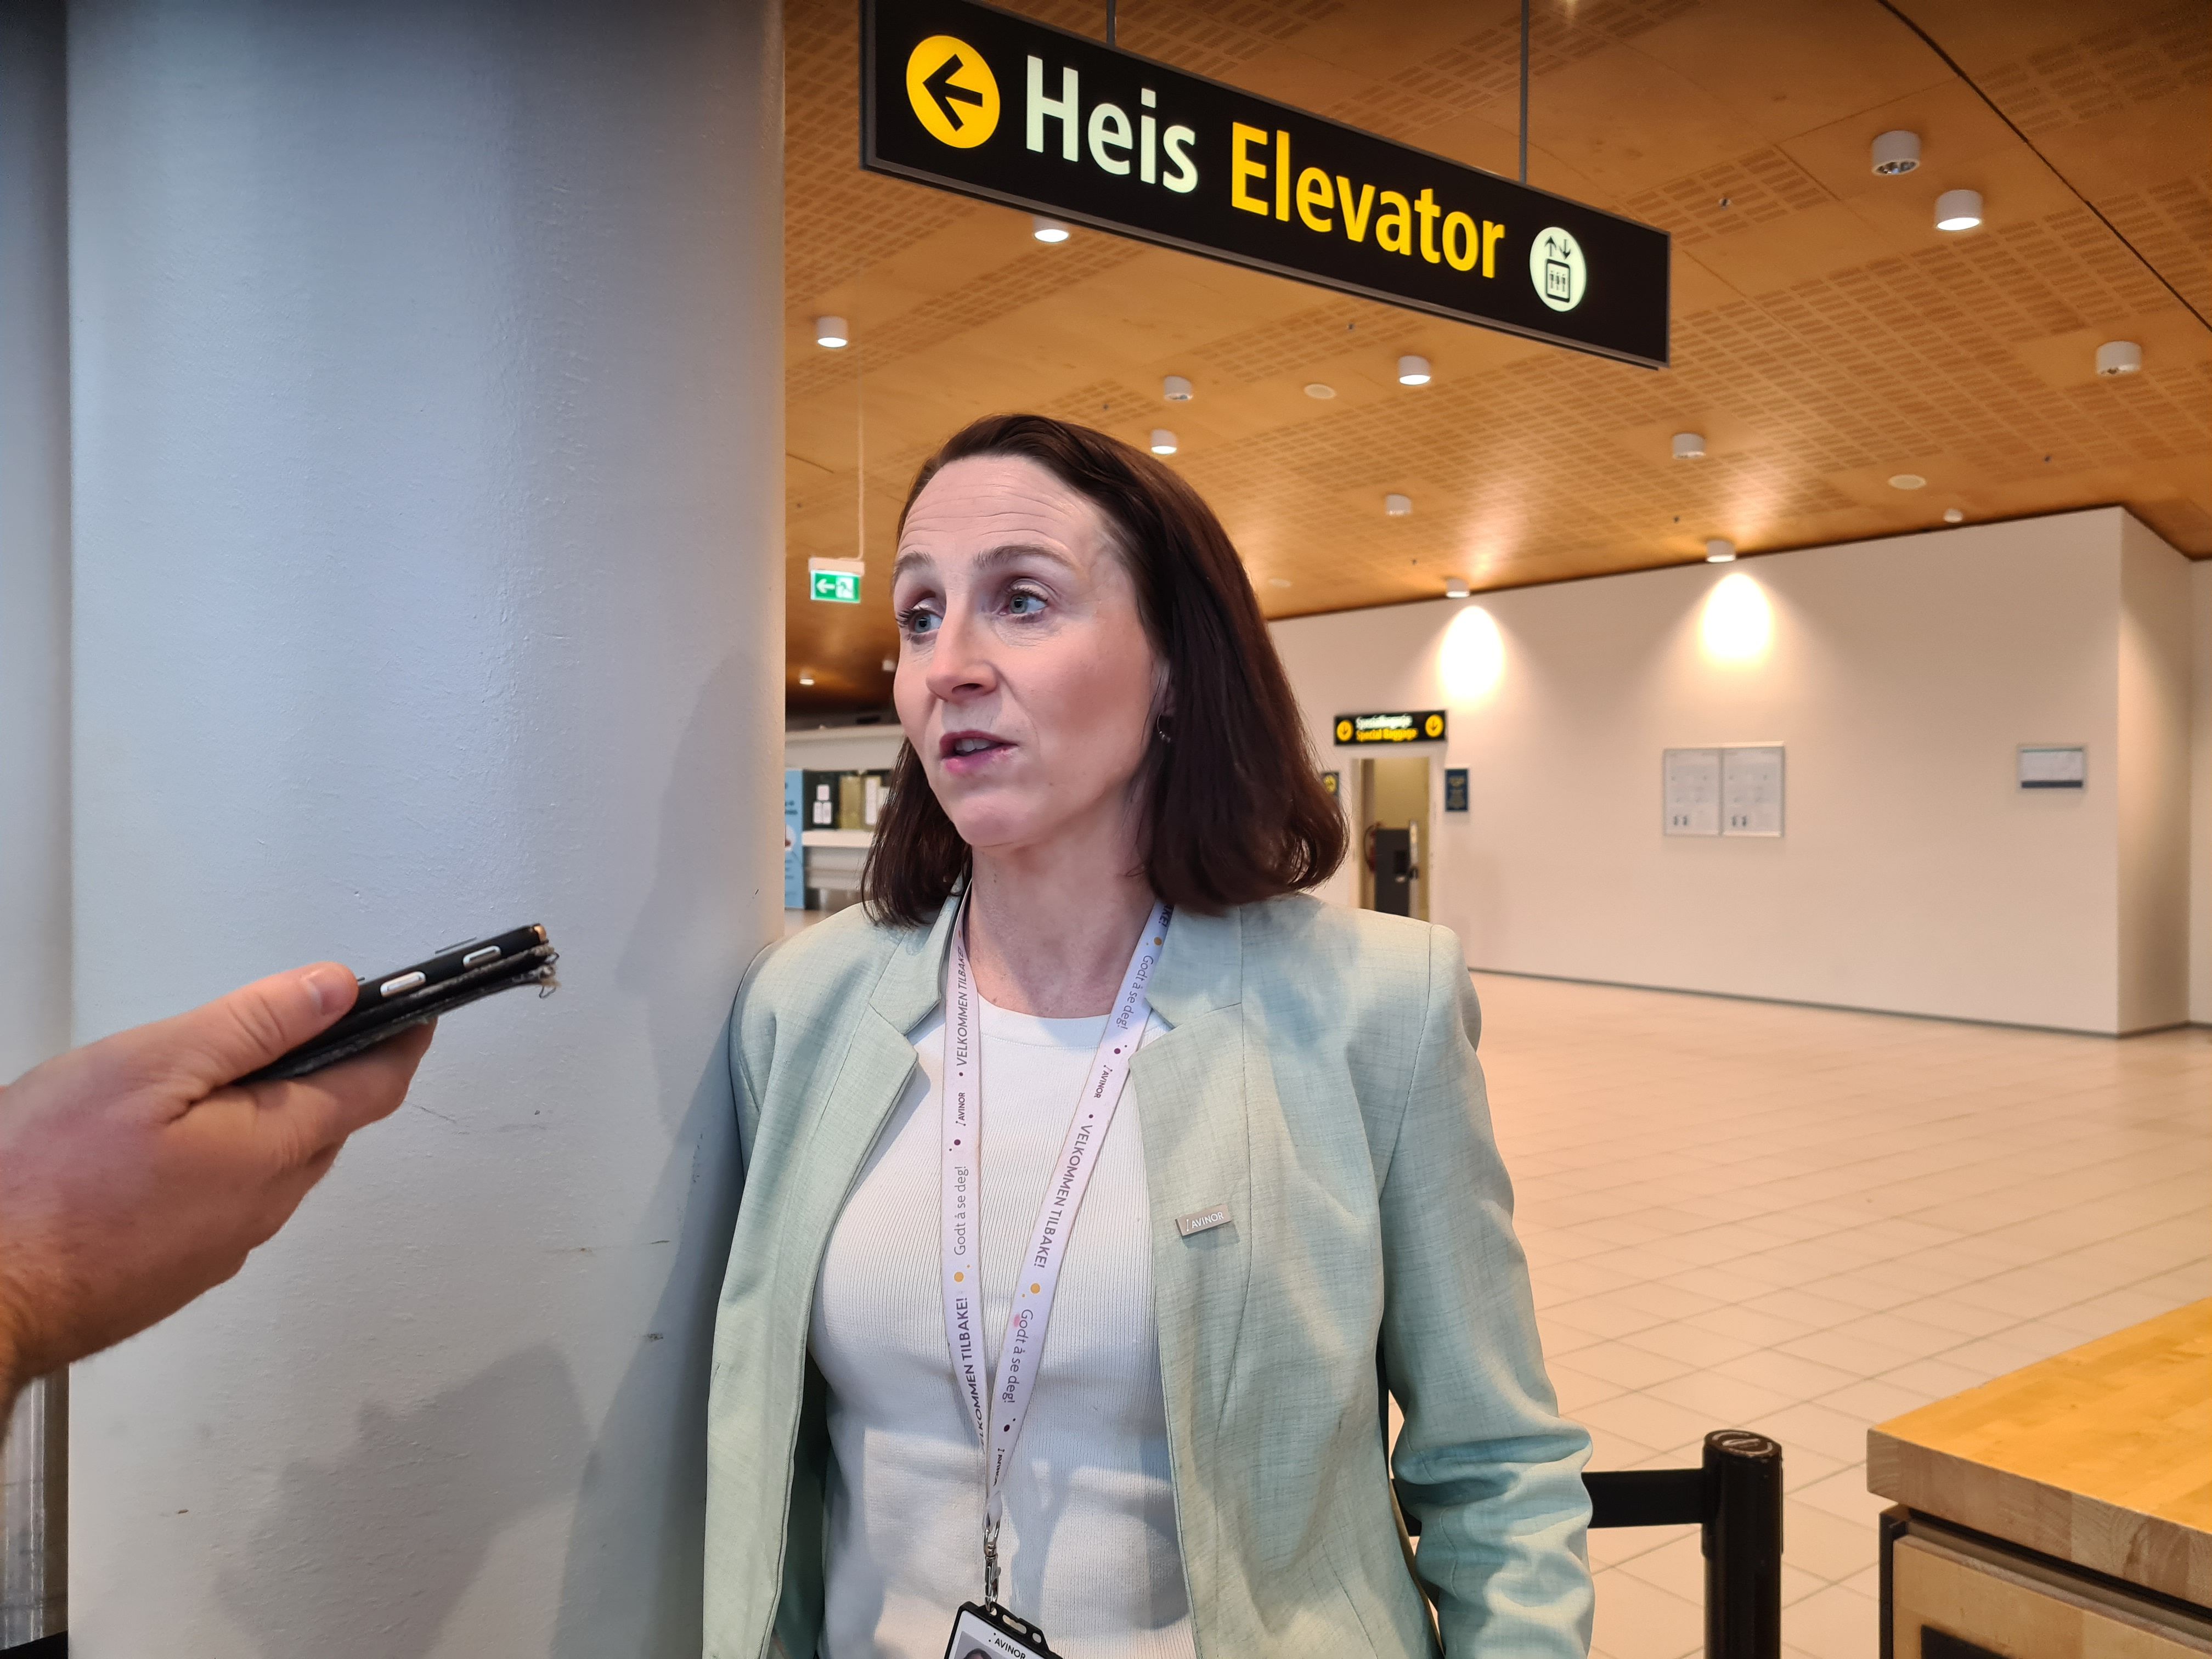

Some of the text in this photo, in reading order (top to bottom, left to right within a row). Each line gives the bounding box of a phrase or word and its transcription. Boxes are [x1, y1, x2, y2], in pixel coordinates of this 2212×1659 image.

[1025, 54, 1505, 278] Heis Elevator
[957, 946, 968, 1066] VELKOMMEN TILBAKE!
[1116, 955, 1154, 1030] Godt å se deg!
[1093, 1070, 1109, 1098] AVINOR
[955, 1166, 969, 1192] deg!
[957, 1195, 966, 1208] se
[1034, 1125, 1093, 1268] VELKOMMEN TILBAKE!
[1192, 1211, 1224, 1229] AVINOR
[954, 1222, 966, 1255] Godt
[956, 1297, 972, 1361] TILBAKE!
[1015, 1309, 1034, 1344] Godt
[1010, 1357, 1020, 1372] se
[1002, 1375, 1019, 1403] deg!
[995, 1638, 1026, 1659] AVINOR
